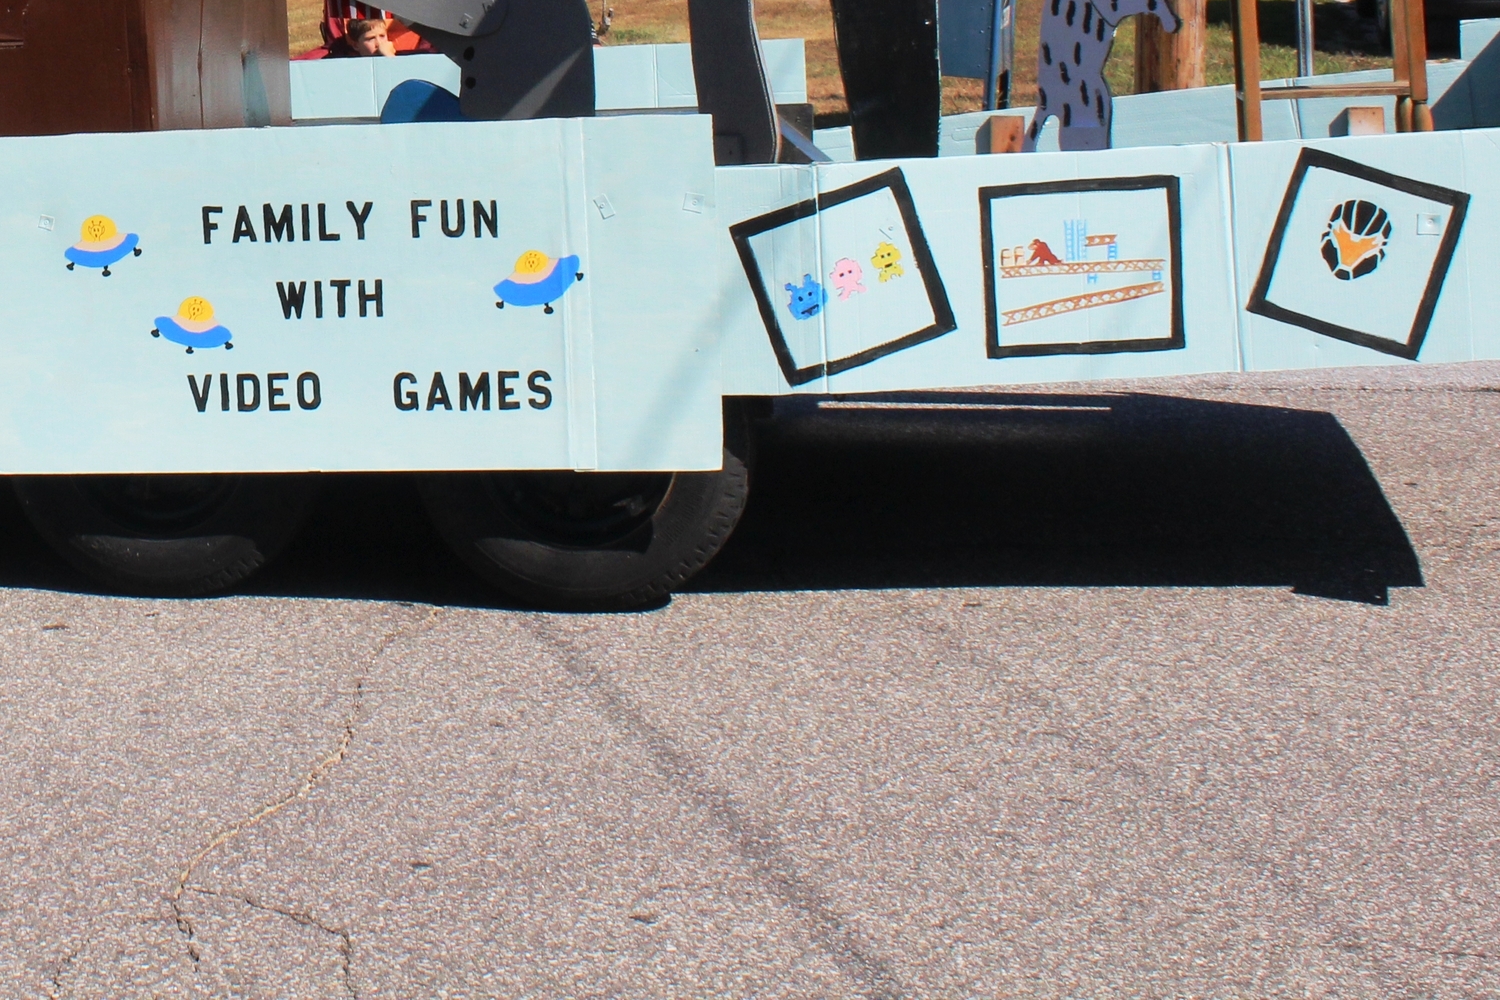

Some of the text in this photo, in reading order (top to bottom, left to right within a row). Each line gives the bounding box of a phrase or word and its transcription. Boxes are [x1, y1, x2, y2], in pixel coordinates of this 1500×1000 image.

[202, 198, 499, 244] FAMILY FUN
[275, 279, 384, 320] WITH
[187, 370, 553, 413] VIDEO GAMES
